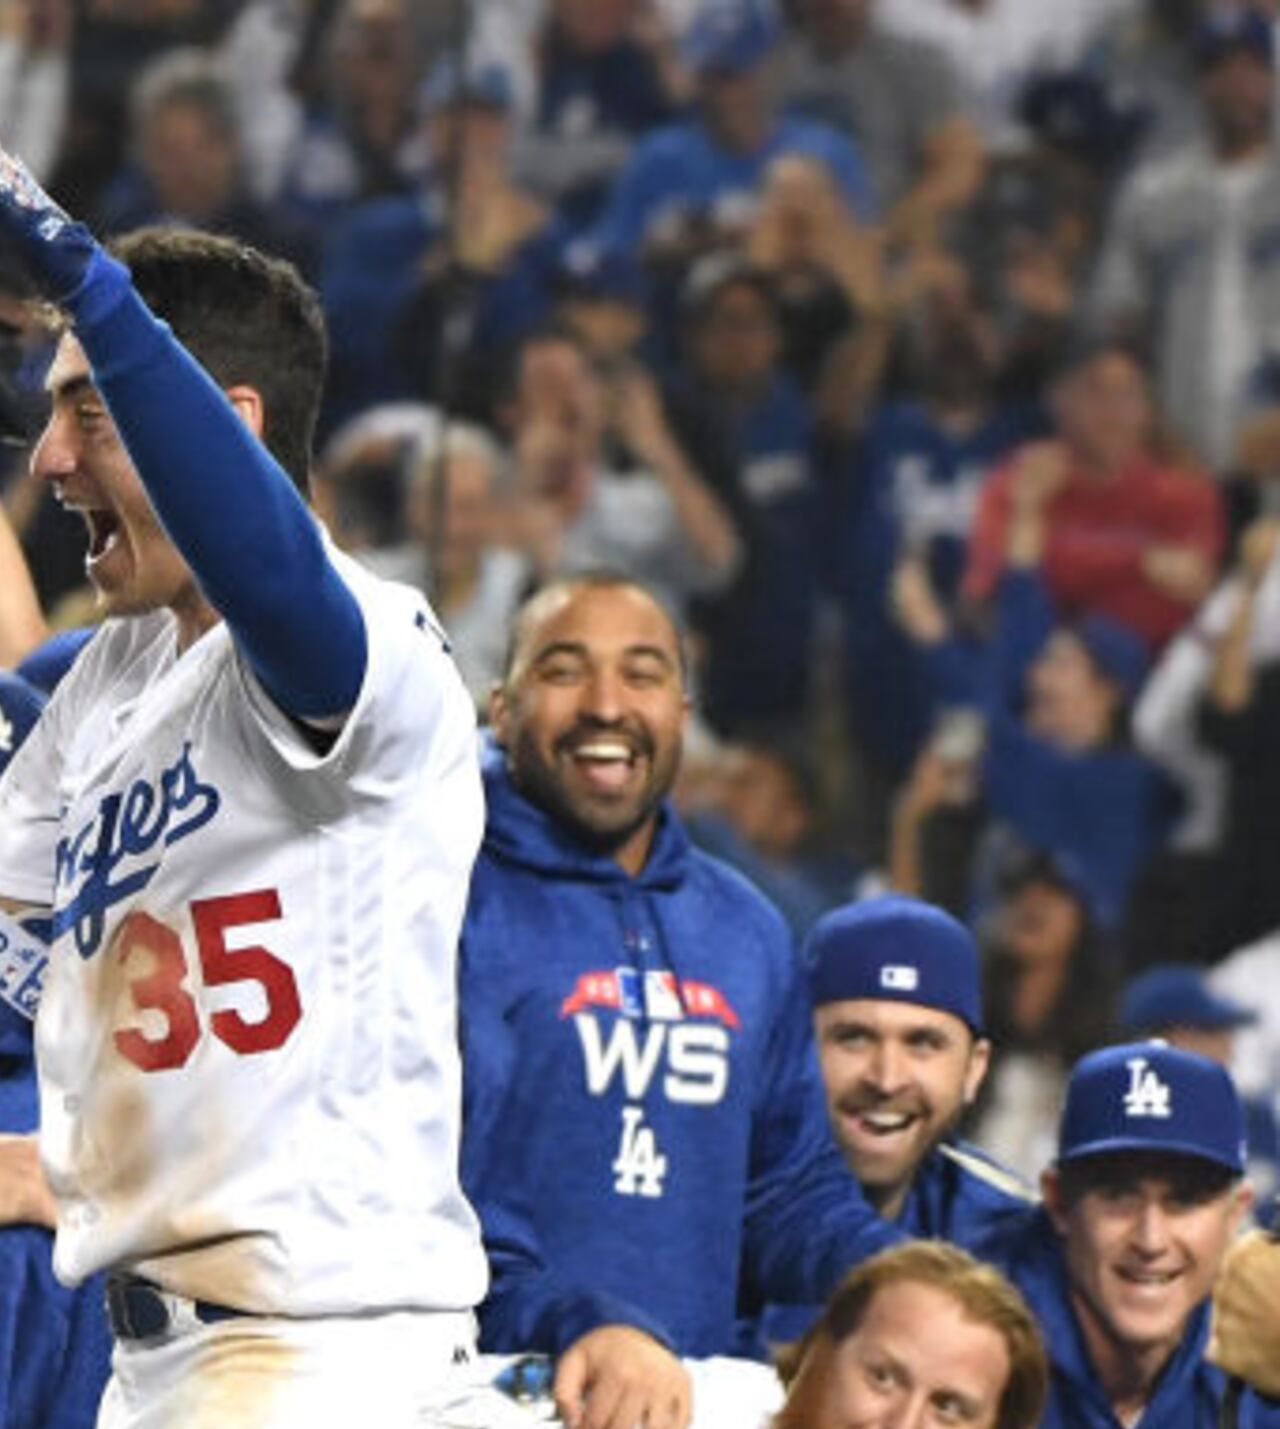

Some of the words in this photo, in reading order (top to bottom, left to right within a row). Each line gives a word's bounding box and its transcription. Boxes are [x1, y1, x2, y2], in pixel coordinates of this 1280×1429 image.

[112, 886, 304, 1074] 35
[574, 1010, 731, 1106] WS
[1123, 1057, 1172, 1118] LA
[612, 1105, 668, 1198] LA
